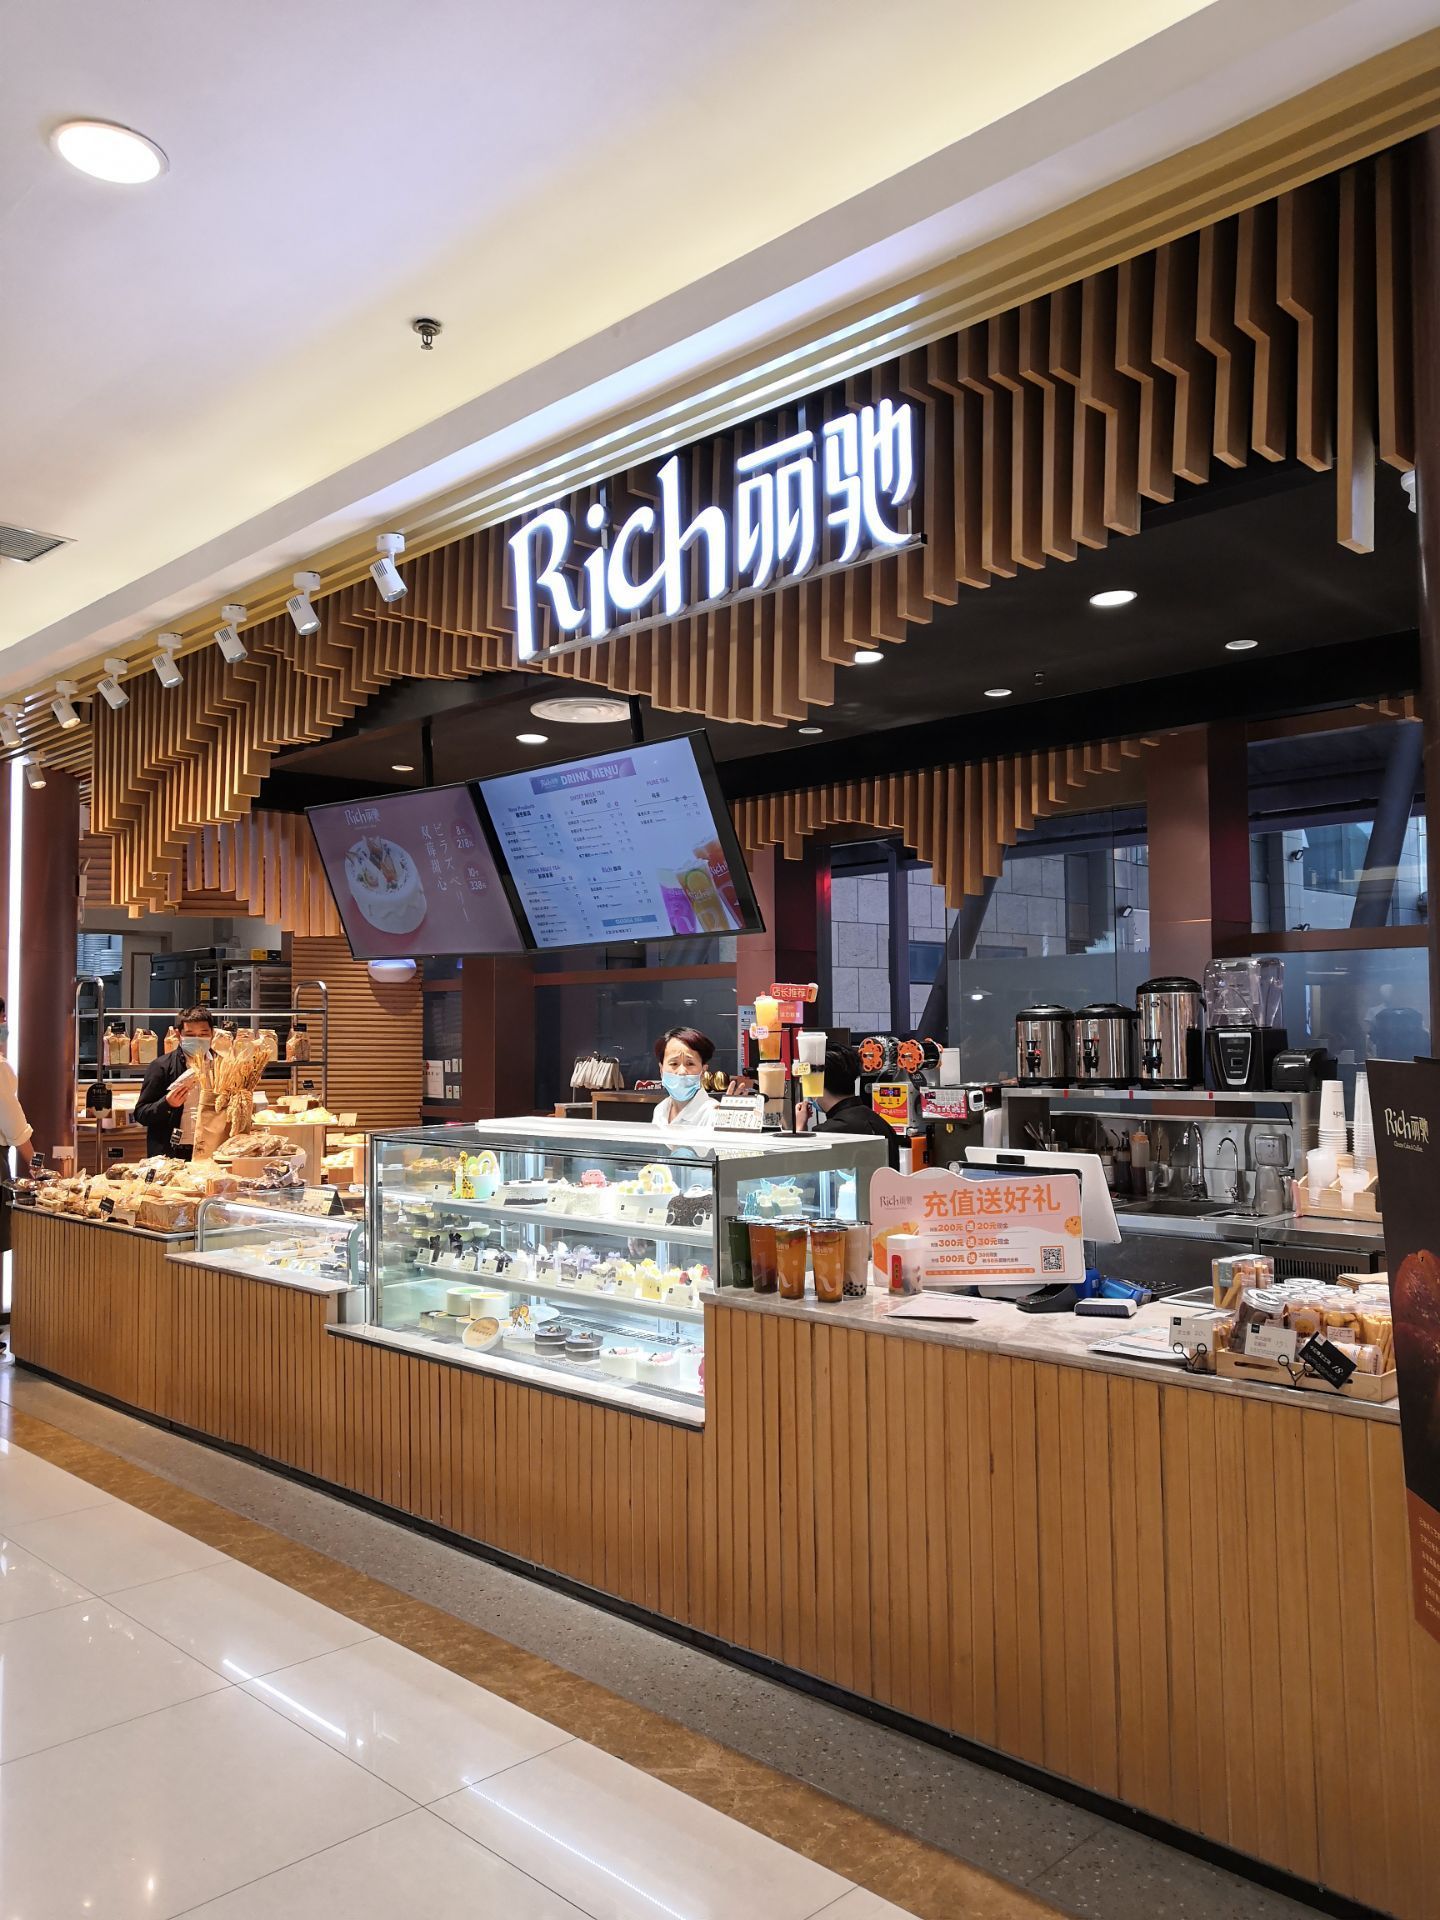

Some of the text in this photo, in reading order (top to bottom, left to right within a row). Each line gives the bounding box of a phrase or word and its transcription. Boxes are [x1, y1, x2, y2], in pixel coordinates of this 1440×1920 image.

[560, 771, 590, 785] DRINK
[591, 764, 618, 778] MENU
[344, 808, 367, 826] Rich
[772, 987, 806, 997] 店长推荐
[1384, 1107, 1411, 1139] Rich
[880, 1195, 899, 1208] Rich
[922, 1183, 1061, 1218] 充值送好礼
